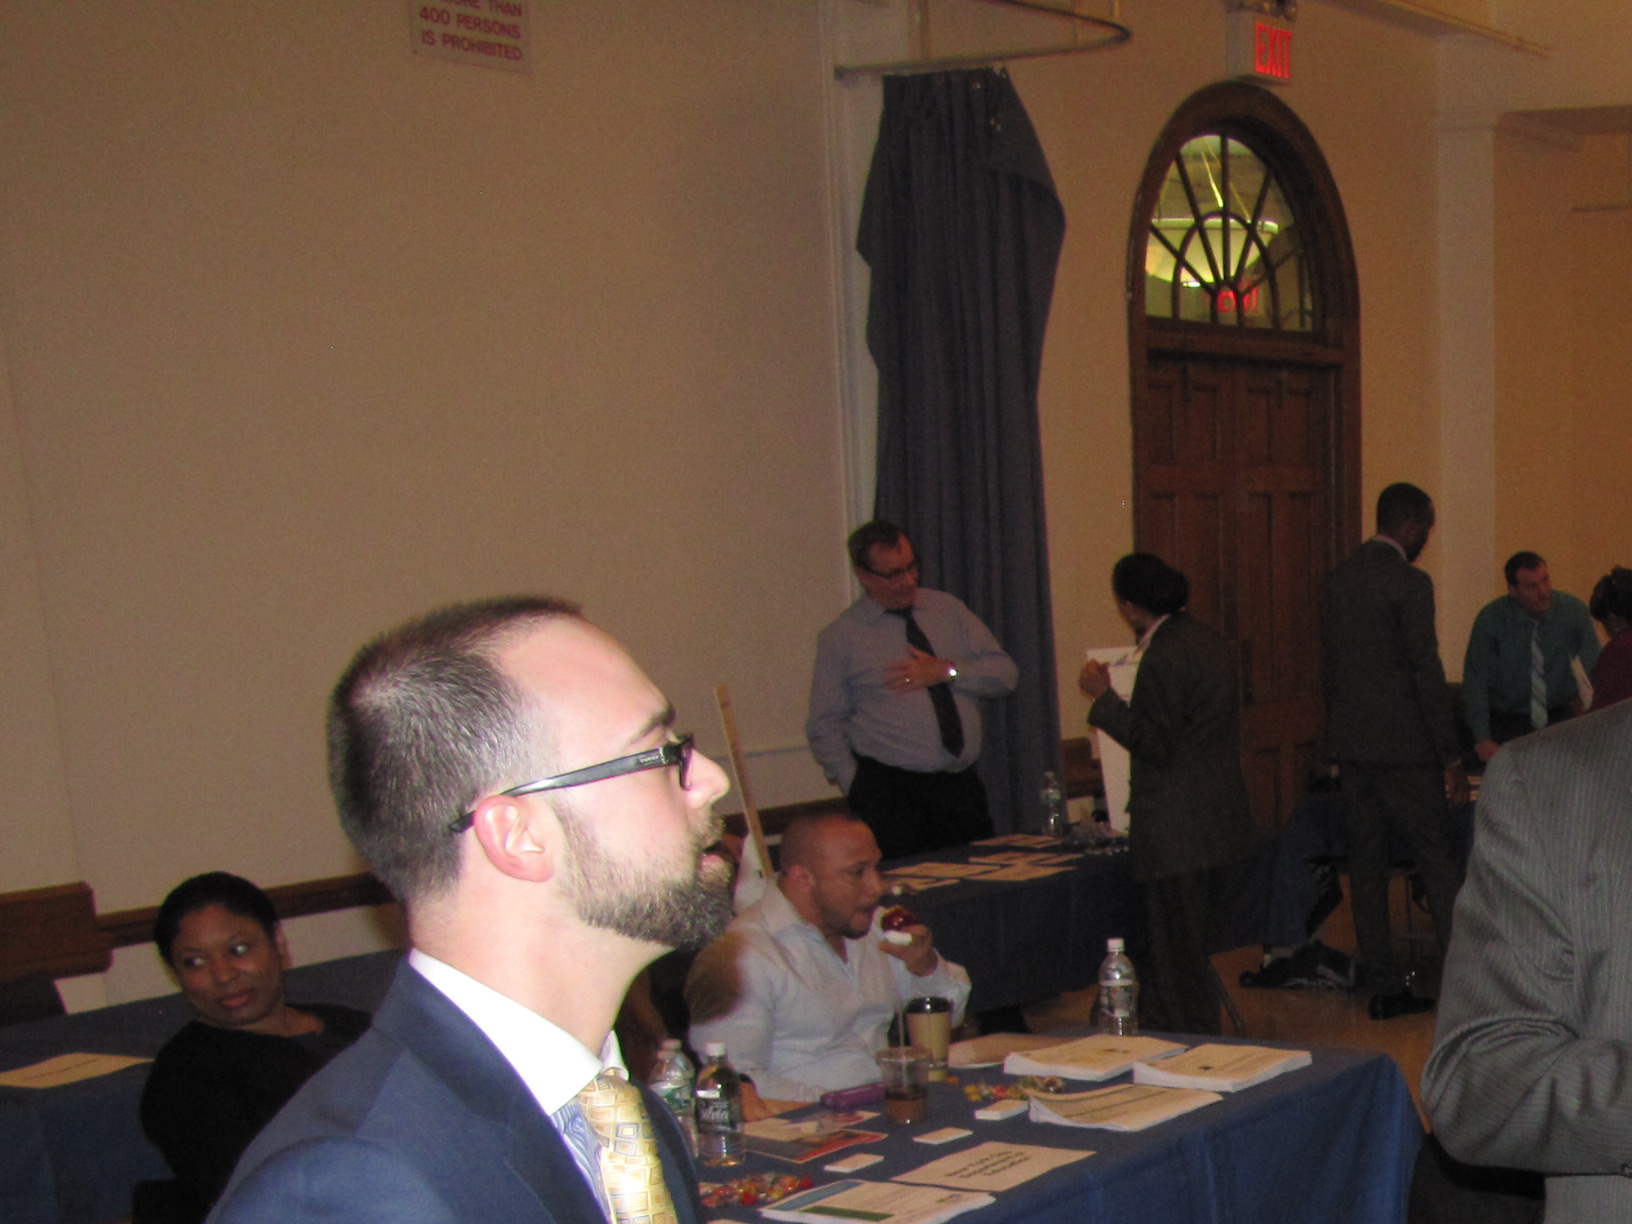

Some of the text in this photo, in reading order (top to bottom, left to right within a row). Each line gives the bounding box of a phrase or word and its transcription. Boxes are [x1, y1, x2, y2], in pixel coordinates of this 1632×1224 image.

[419, 6, 522, 39] 400 PERSONS
[421, 30, 523, 61] IS PROHIBITED
[1255, 21, 1292, 78] EXIT
